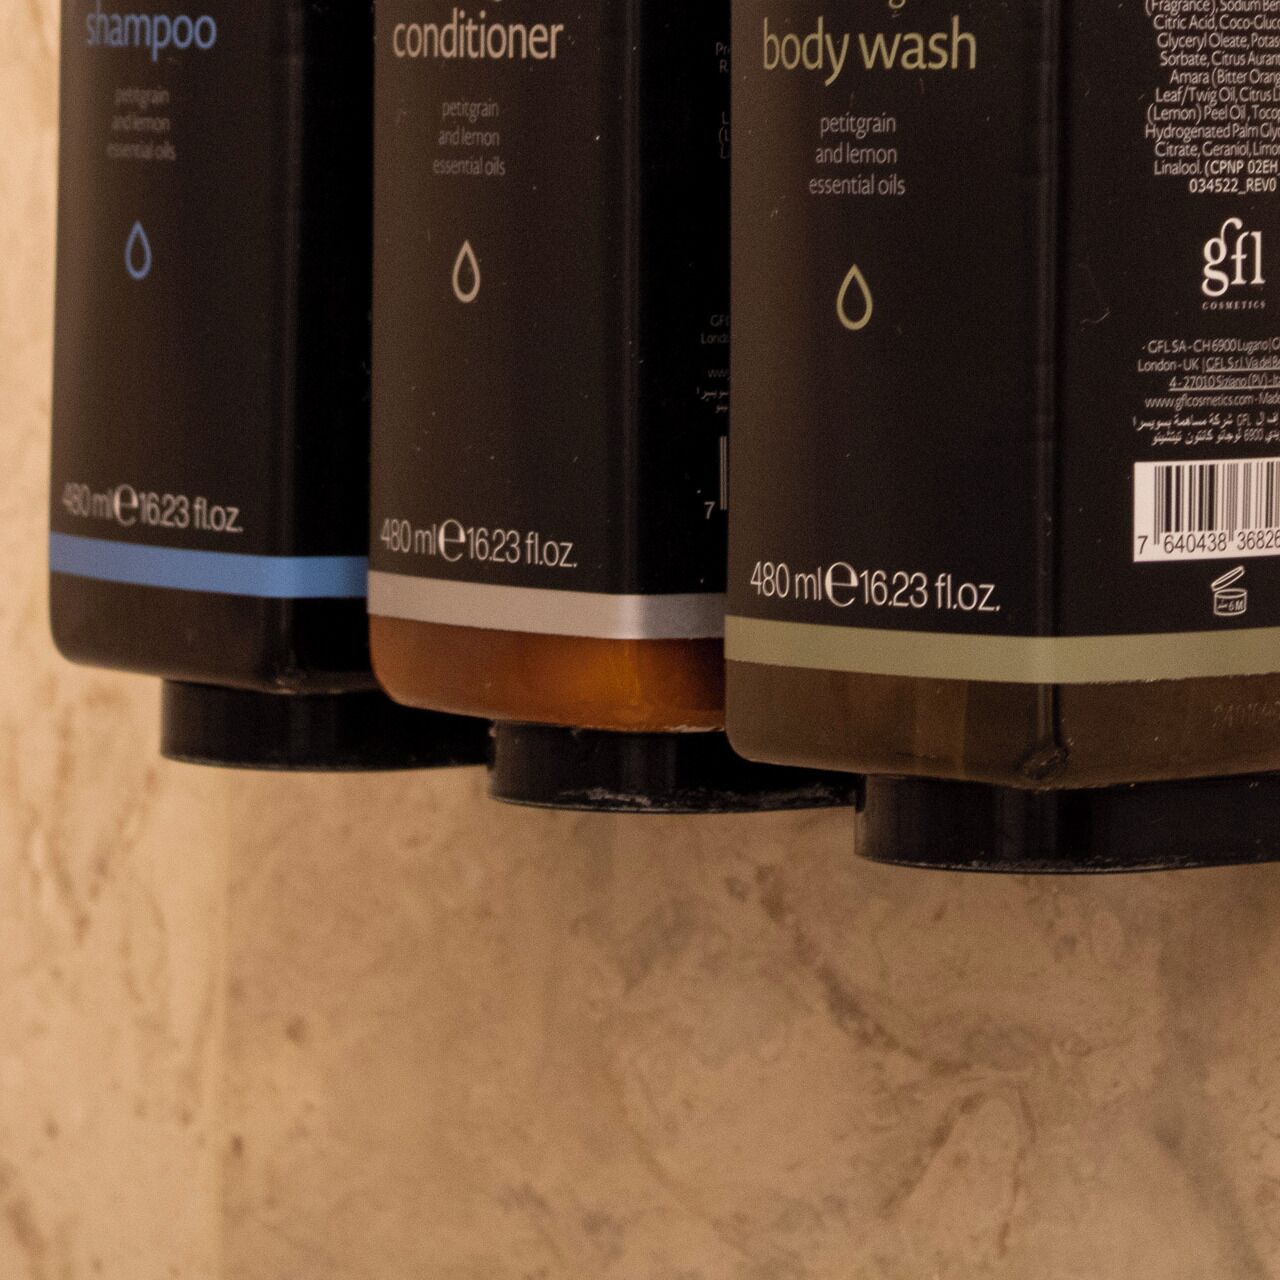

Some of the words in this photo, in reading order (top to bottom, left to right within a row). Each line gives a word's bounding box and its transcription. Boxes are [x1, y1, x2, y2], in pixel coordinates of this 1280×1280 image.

[1153, 14, 1186, 30] Citric
[1189, 14, 1217, 31] Acid,
[393, 7, 564, 59] conditioner
[1157, 33, 1207, 51] Glyceryl
[1209, 33, 1250, 50] Oleate,
[763, 16, 850, 87] body
[858, 15, 976, 70] wash
[1160, 51, 1210, 68] Sorbate,
[1211, 51, 1245, 66] Citrus
[1170, 70, 1209, 85] Amara
[1211, 67, 1248, 88] (Bitter
[1155, 86, 1217, 106] Leaf/Twig
[1219, 86, 1238, 103] Oil,
[1239, 87, 1270, 102] Citrus
[442, 98, 499, 123] petitgrain
[1147, 103, 1201, 124] (Lemon)
[1204, 105, 1228, 120] Peel
[820, 112, 896, 139] petitgrain
[1145, 123, 1230, 143] Hydrogenated
[1232, 123, 1258, 138] Palm
[438, 126, 459, 145] and
[462, 126, 500, 146] lemon
[816, 142, 843, 163] and
[846, 142, 896, 164] lemon
[1155, 142, 1200, 157] Citrate,
[1202, 141, 1252, 157] Geraniol,
[433, 156, 483, 175] essential
[486, 156, 505, 176] oils
[1154, 160, 1202, 175] Linalool.
[1204, 159, 1244, 177] (CPNP
[809, 173, 874, 195] essential
[878, 173, 906, 196] oils
[1189, 178, 1277, 195] 034522_REV0
[1201, 217, 1266, 297] gfl
[1202, 300, 1266, 311] COSMETICS
[1147, 339, 1170, 354] GFL
[1172, 339, 1186, 353] SA
[704, 501, 715, 519] 7
[380, 518, 411, 552] 480
[414, 523, 437, 555] ml
[467, 527, 520, 564] 16.23
[525, 531, 578, 568] fl.oz.
[1137, 535, 1148, 555] 7
[1163, 532, 1227, 554] 640438
[750, 561, 789, 598] 480
[795, 566, 822, 601] ml
[859, 569, 928, 608] 16.23
[934, 573, 1001, 611] fl.oz.
